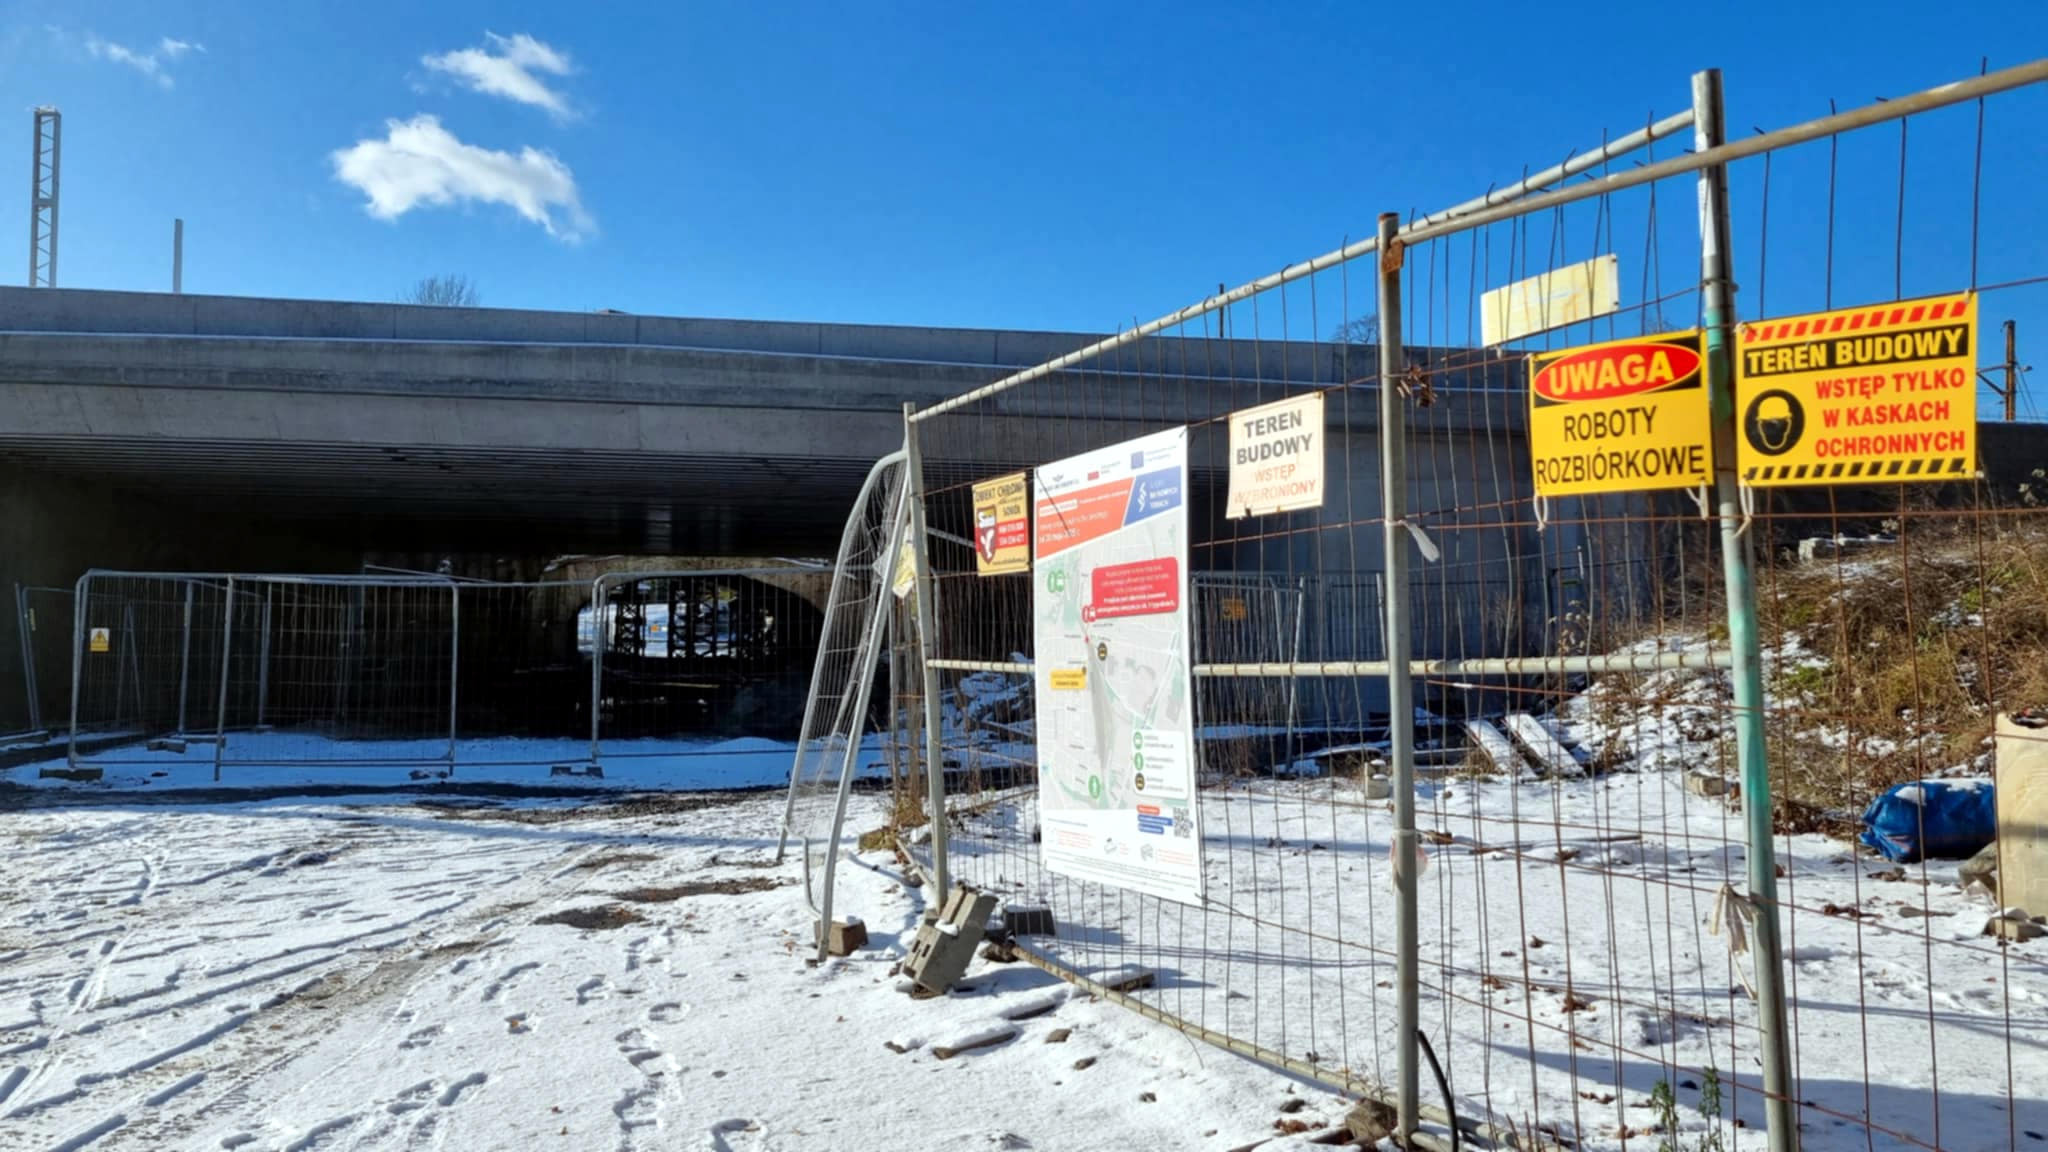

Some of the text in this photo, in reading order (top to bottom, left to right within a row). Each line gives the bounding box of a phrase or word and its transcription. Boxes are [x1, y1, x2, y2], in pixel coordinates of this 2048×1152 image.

[1747, 328, 1964, 374] TEREN BUDOWY
[1550, 350, 1675, 395] UWAGA
[1815, 368, 1965, 400] WSTĘP TYLKO
[1243, 409, 1302, 439] TEREN
[1563, 405, 1657, 442] ROBOTY
[1823, 401, 1949, 428] W KASKACH
[1236, 432, 1313, 465] BUDOWY
[1815, 431, 1965, 458] OCHRONNYCH
[1536, 444, 1705, 485] ROZBIÓRKOWE
